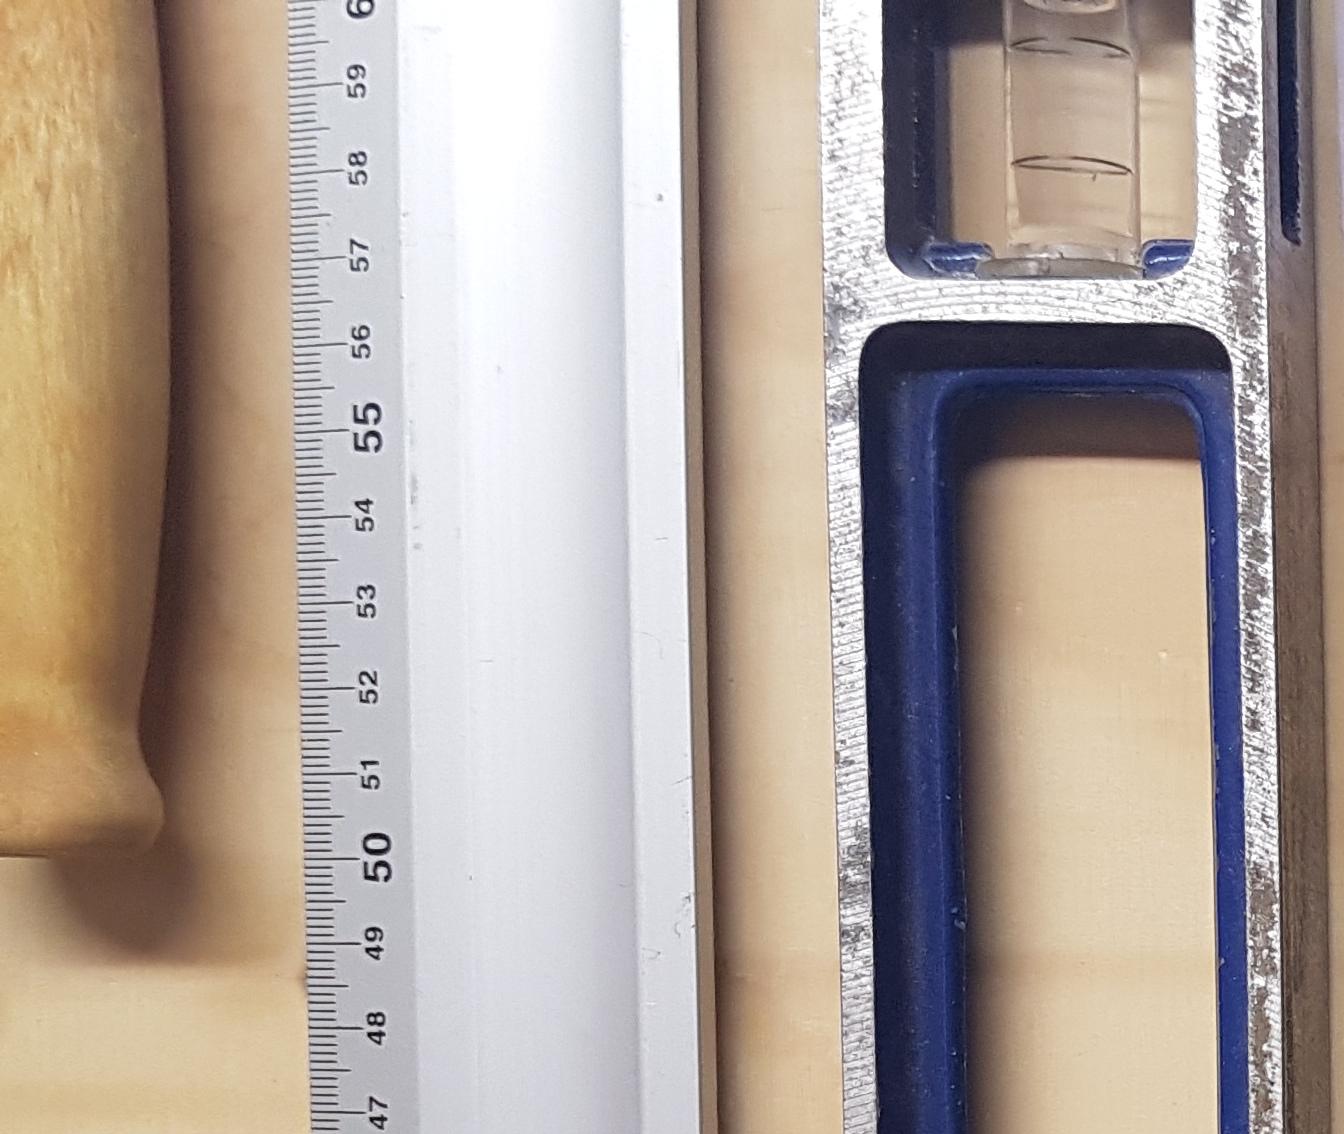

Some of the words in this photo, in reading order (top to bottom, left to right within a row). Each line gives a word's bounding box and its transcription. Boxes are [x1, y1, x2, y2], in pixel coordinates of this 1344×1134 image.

[346, 0, 374, 19] 6
[347, 64, 366, 98] 59
[349, 151, 368, 185] 58
[350, 239, 369, 272] 57
[352, 324, 370, 360] 56
[354, 402, 382, 453] 55
[356, 498, 375, 532] 54
[357, 584, 377, 619] 53
[359, 670, 378, 705] 52
[361, 760, 380, 790] 51
[363, 833, 392, 882] 50
[365, 926, 383, 961] 49
[367, 1012, 386, 1046] 48
[369, 1096, 388, 1130] 47
